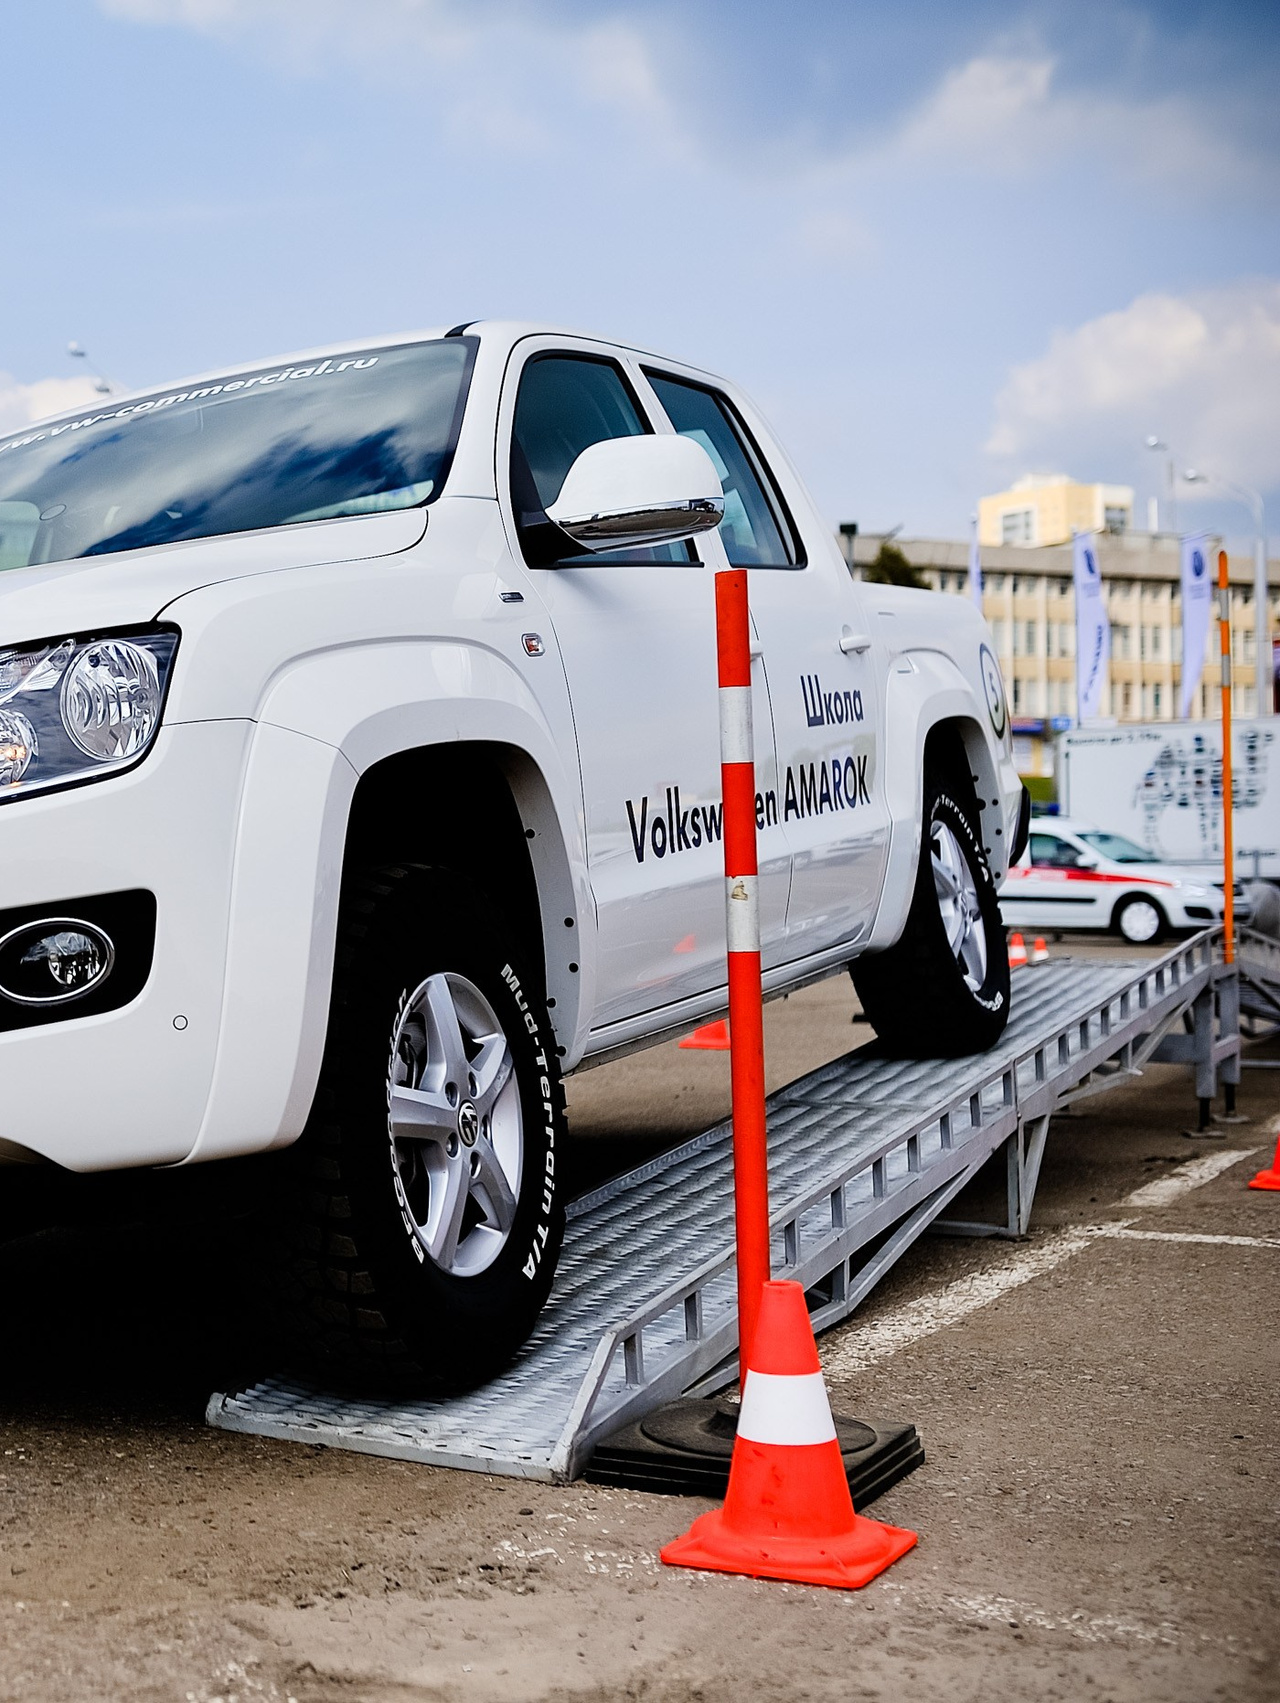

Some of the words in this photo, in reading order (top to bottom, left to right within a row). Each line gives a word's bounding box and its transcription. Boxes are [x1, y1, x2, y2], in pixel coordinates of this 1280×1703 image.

[800, 674, 864, 727] Школа
[625, 785, 778, 864] Volkswen
[784, 755, 871, 822] AMAROK
[500, 963, 559, 1215] Mud-Terrain
